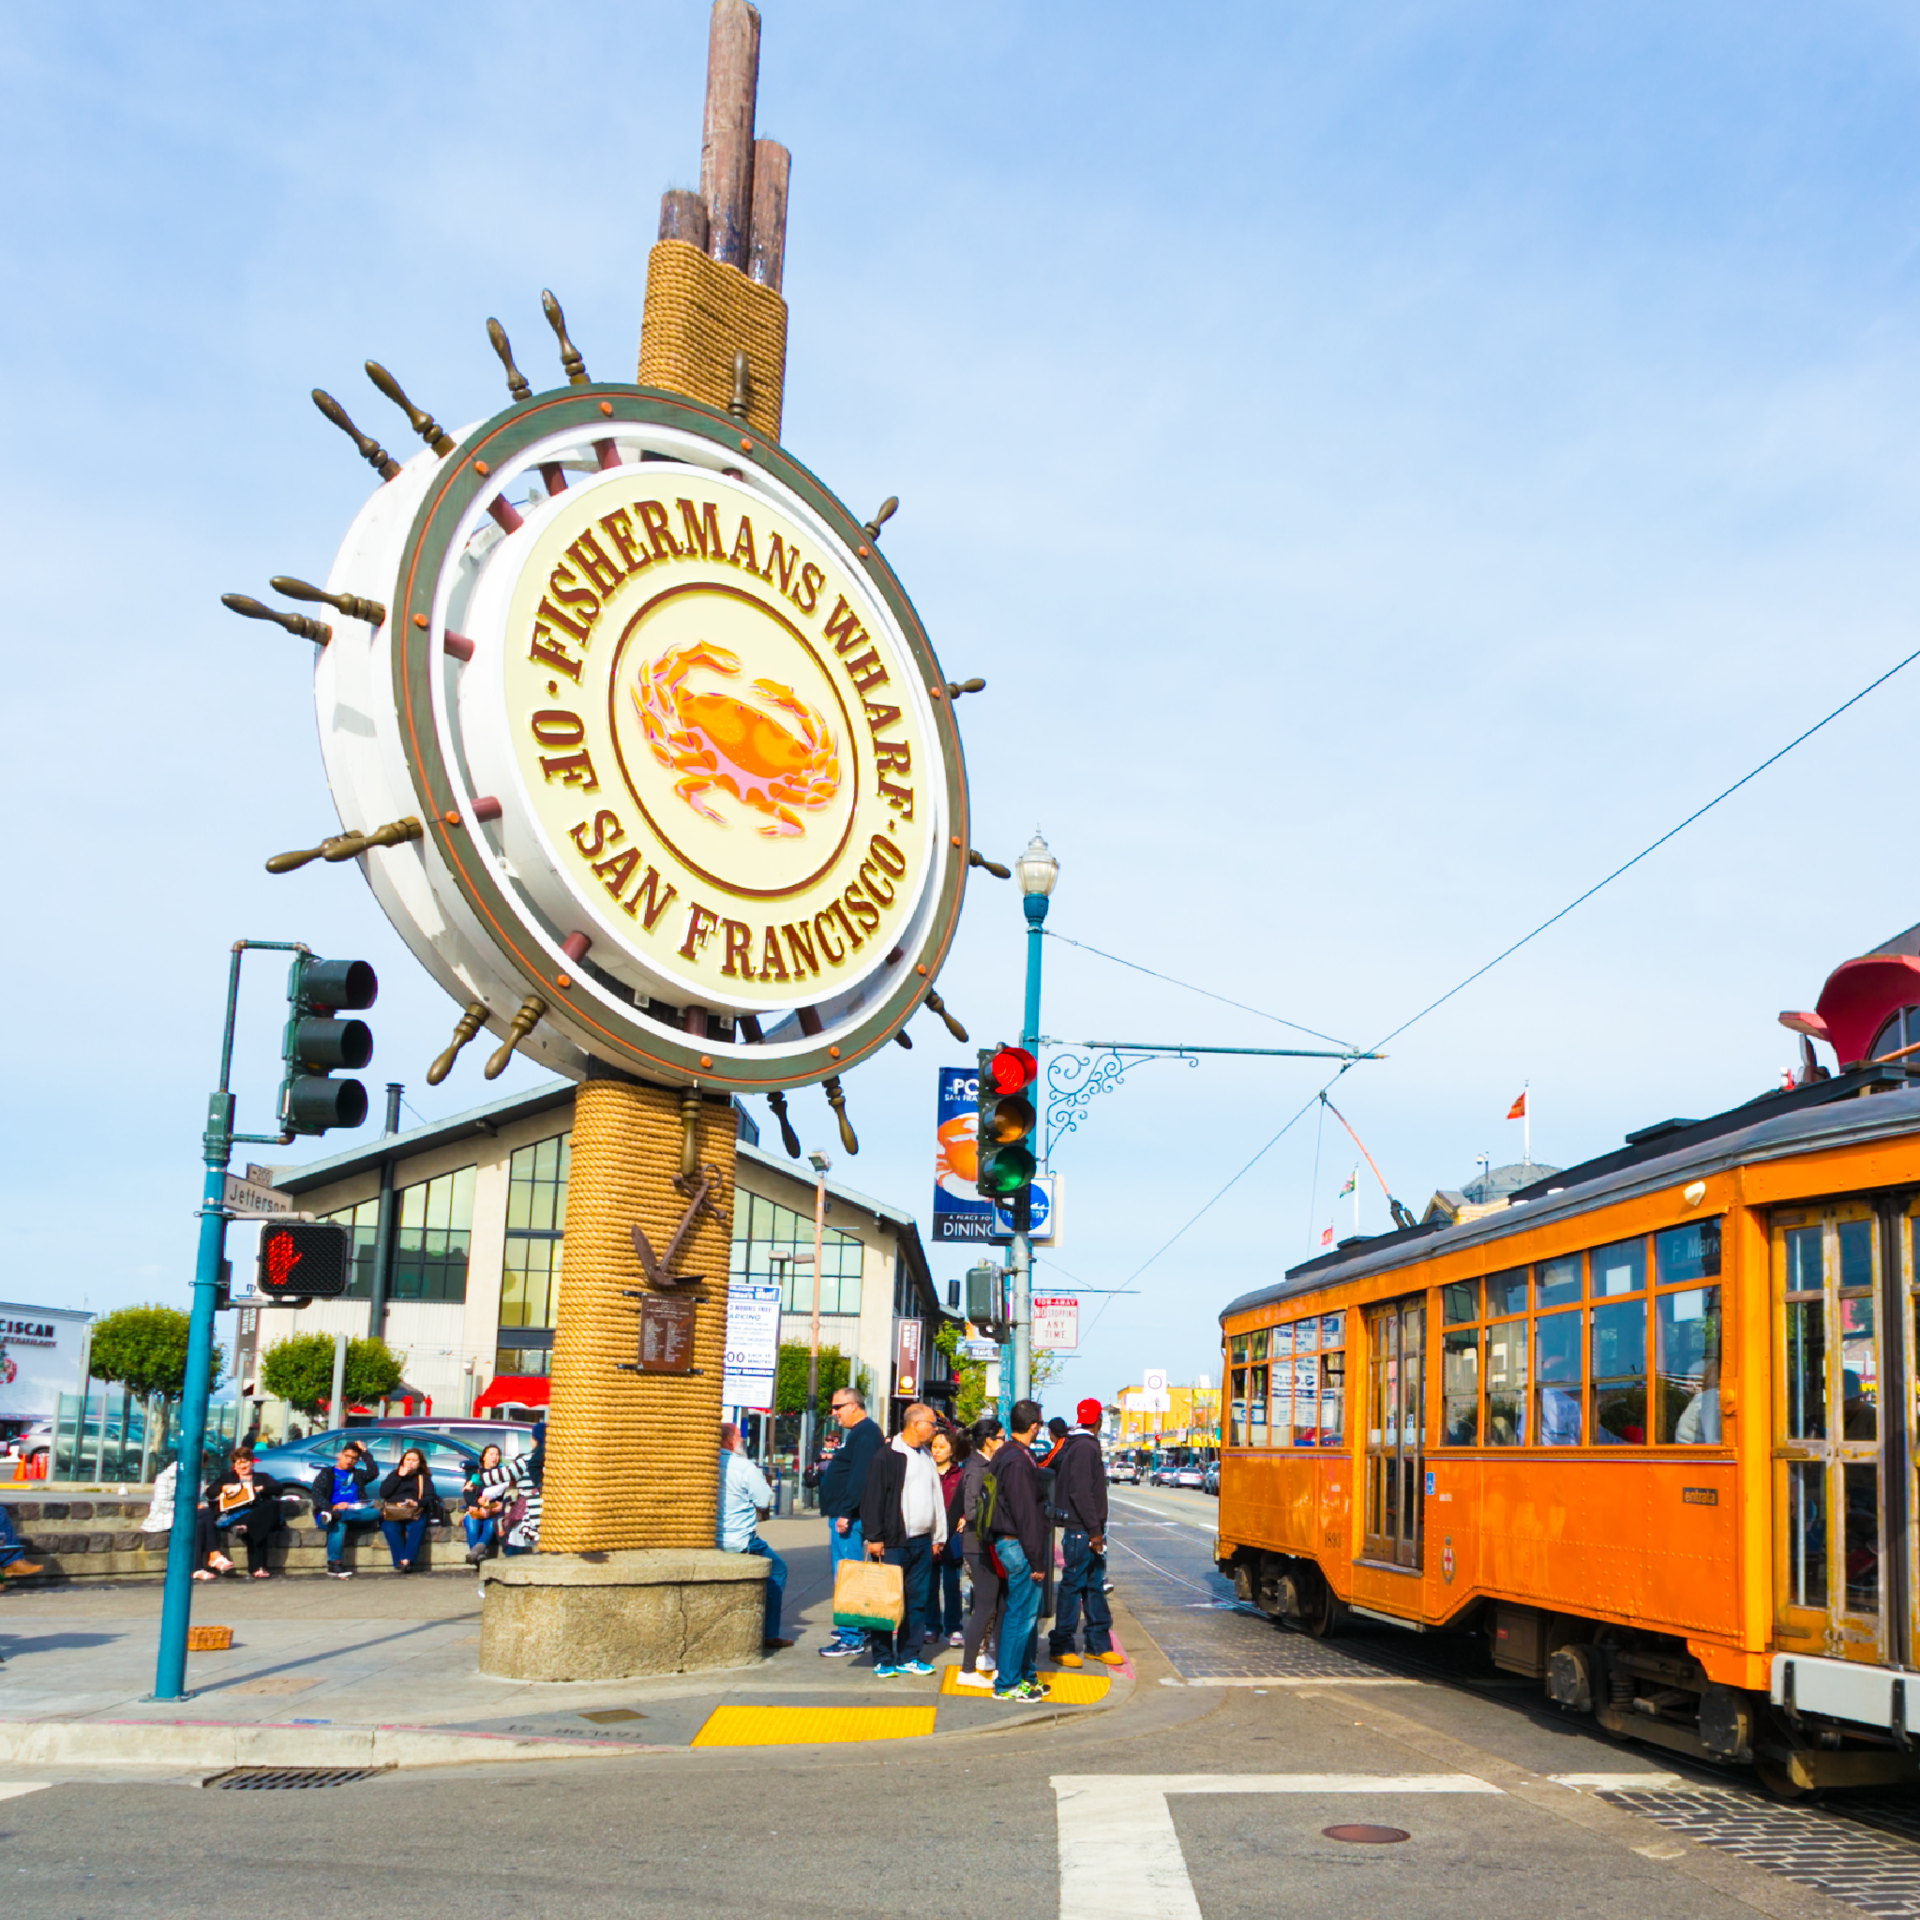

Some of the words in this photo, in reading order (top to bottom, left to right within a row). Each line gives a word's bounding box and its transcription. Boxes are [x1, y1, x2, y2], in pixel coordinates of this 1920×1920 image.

[527, 496, 828, 682] FISHERMANS
[822, 594, 916, 821] WHARF
[530, 708, 601, 793] OF
[569, 808, 677, 932] SAN
[677, 832, 908, 981] FRANCISCO
[229, 1183, 288, 1213] Jefferson
[728, 1313, 761, 1322] ARKING
[1047, 1321, 1065, 1329] ANY
[1044, 1329, 1066, 1339] TIME
[1685, 1489, 1716, 1504] entrata
